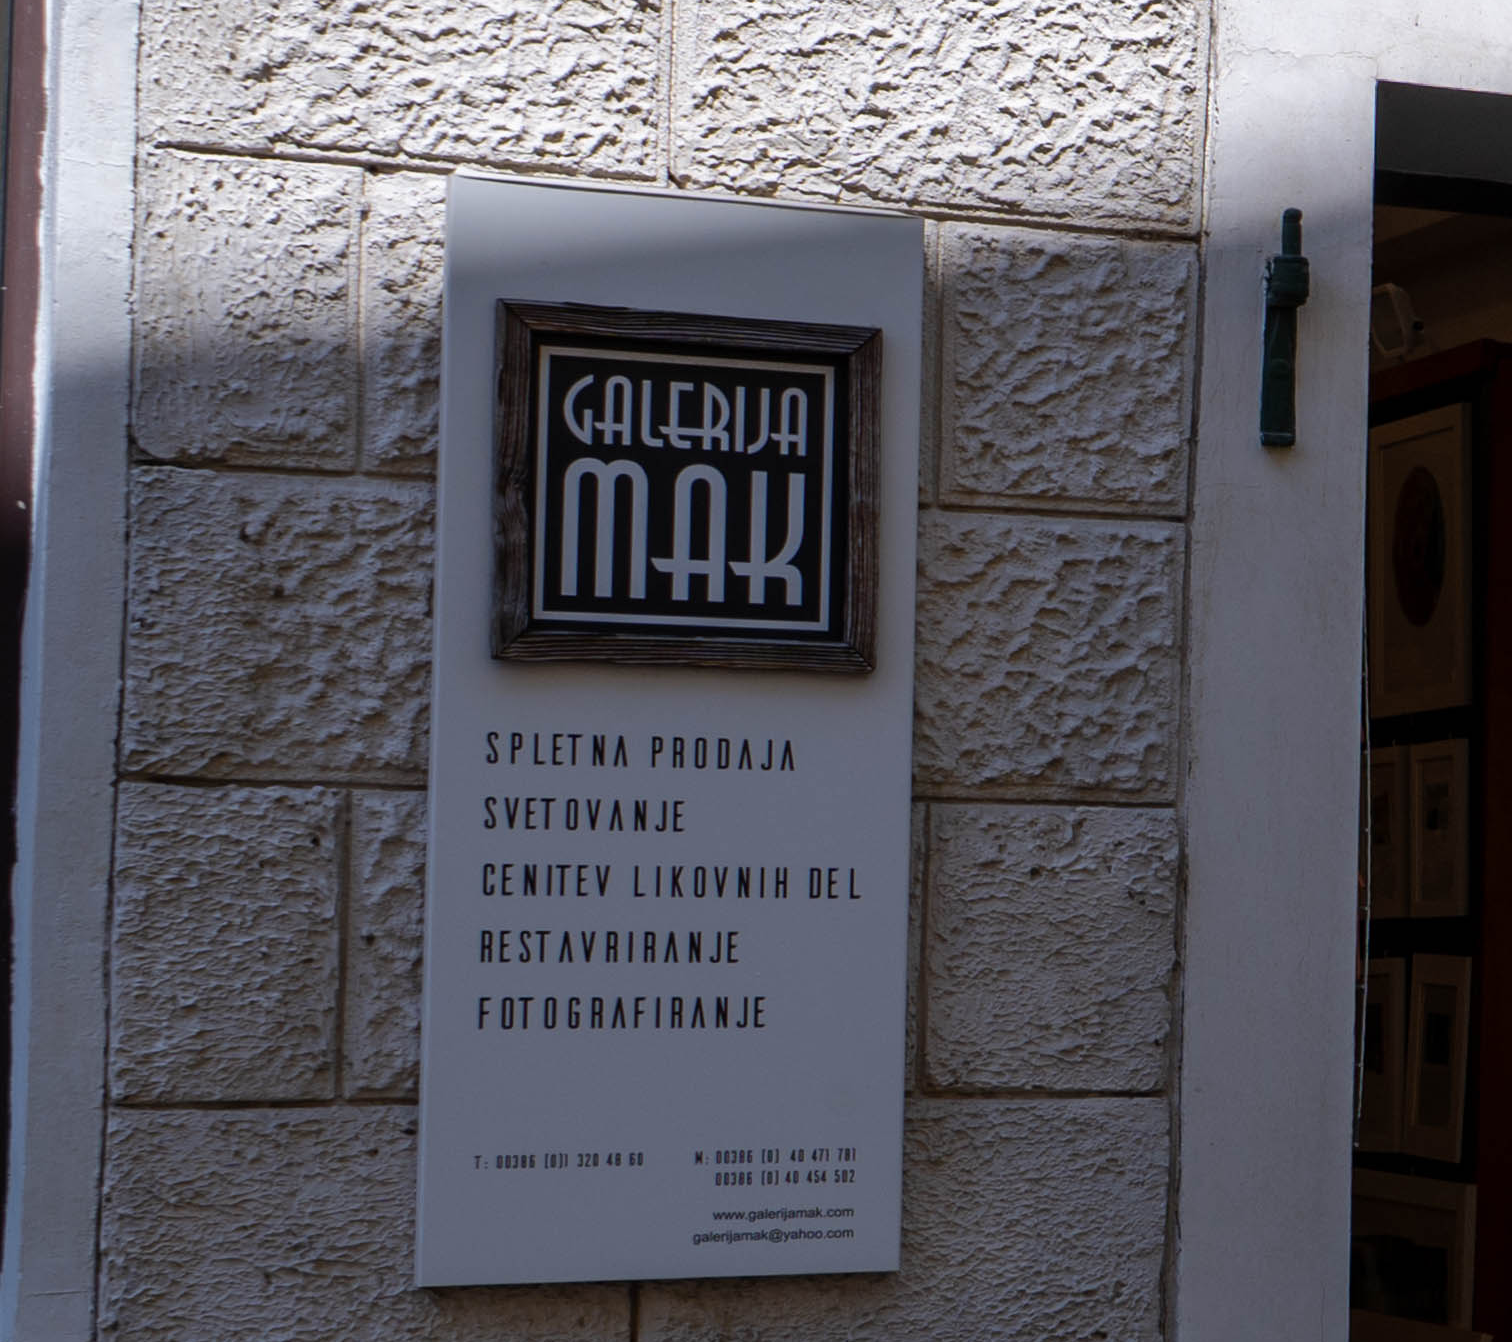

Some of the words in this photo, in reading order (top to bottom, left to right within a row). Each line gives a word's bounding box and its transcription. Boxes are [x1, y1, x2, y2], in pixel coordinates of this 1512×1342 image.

[562, 374, 808, 457] GALERIJA
[560, 457, 807, 607] MAK
[485, 731, 629, 767] SPLETNA
[650, 735, 797, 771] PRODAJA
[483, 796, 687, 833] SVETOVANJE
[482, 863, 611, 897] CENITEV
[633, 865, 790, 899] LIKOVNIH
[808, 866, 862, 901] DEL
[479, 929, 740, 964] RESTAVRIRANJE
[477, 995, 768, 1030] FOTOGRAFIRANJE
[473, 1154, 489, 1170] T:
[496, 1154, 536, 1170] 00386
[577, 1153, 599, 1168] 320
[629, 1152, 644, 1167] 60
[716, 1149, 753, 1164] 00386
[790, 1148, 805, 1163] 40
[812, 1148, 830, 1163] 471
[715, 1171, 753, 1187] 00386
[785, 1170, 799, 1185] 40
[806, 1169, 827, 1184] 454
[834, 1169, 856, 1184] 502
[712, 1207, 855, 1223] www.galerijamak.com
[693, 1227, 855, 1246] galerijamak@yahoo.com
